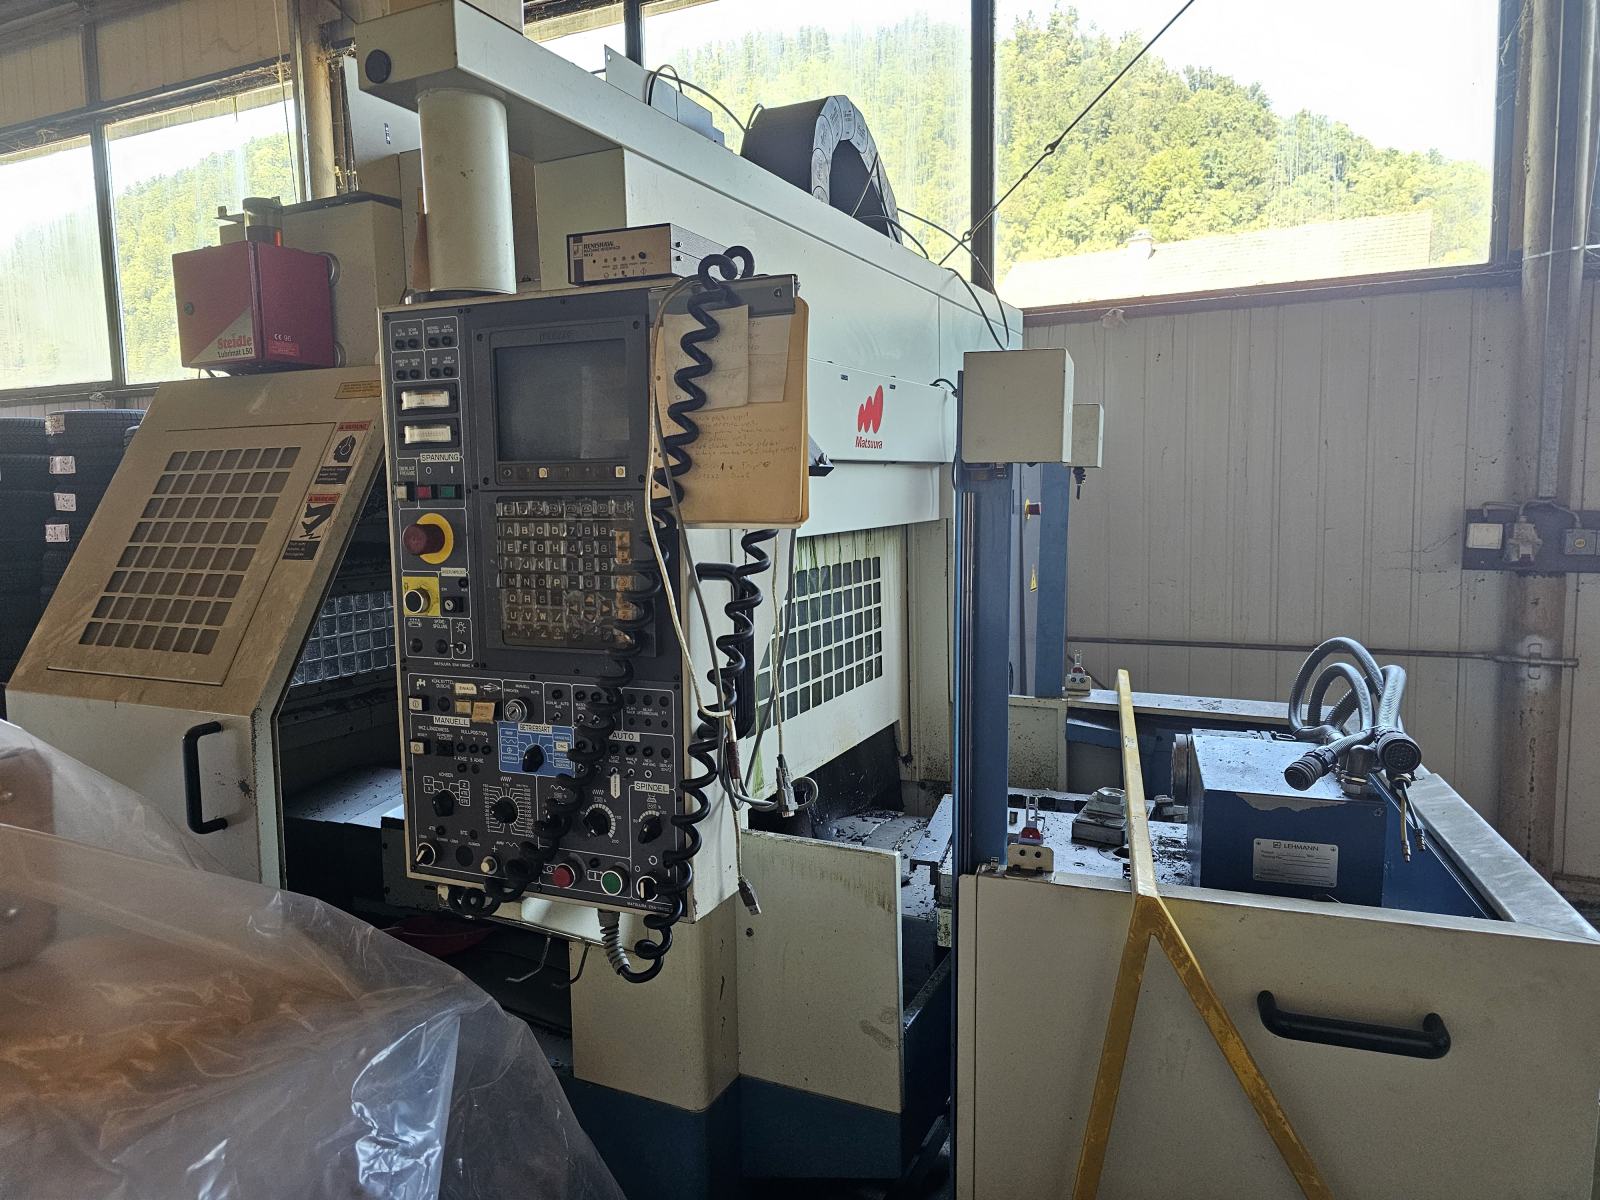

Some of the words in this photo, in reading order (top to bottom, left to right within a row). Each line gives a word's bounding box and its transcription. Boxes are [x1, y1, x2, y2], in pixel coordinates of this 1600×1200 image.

[583, 240, 614, 250] RENISHAW
[217, 335, 252, 349] Steidle
[217, 349, 241, 358] Lubrimat
[421, 453, 458, 462] SPANNUNG
[536, 526, 543, 534] C
[552, 526, 558, 534] D
[569, 526, 575, 534] 7
[584, 526, 591, 534] 8
[586, 544, 591, 552] 5
[538, 561, 544, 569] K
[554, 561, 559, 569] L
[510, 612, 516, 620] U
[434, 717, 468, 726] MANUELL
[519, 724, 550, 733] BETRIEBSART
[636, 782, 668, 792] SPINDEL
[1284, 844, 1318, 852] LEHMANN
